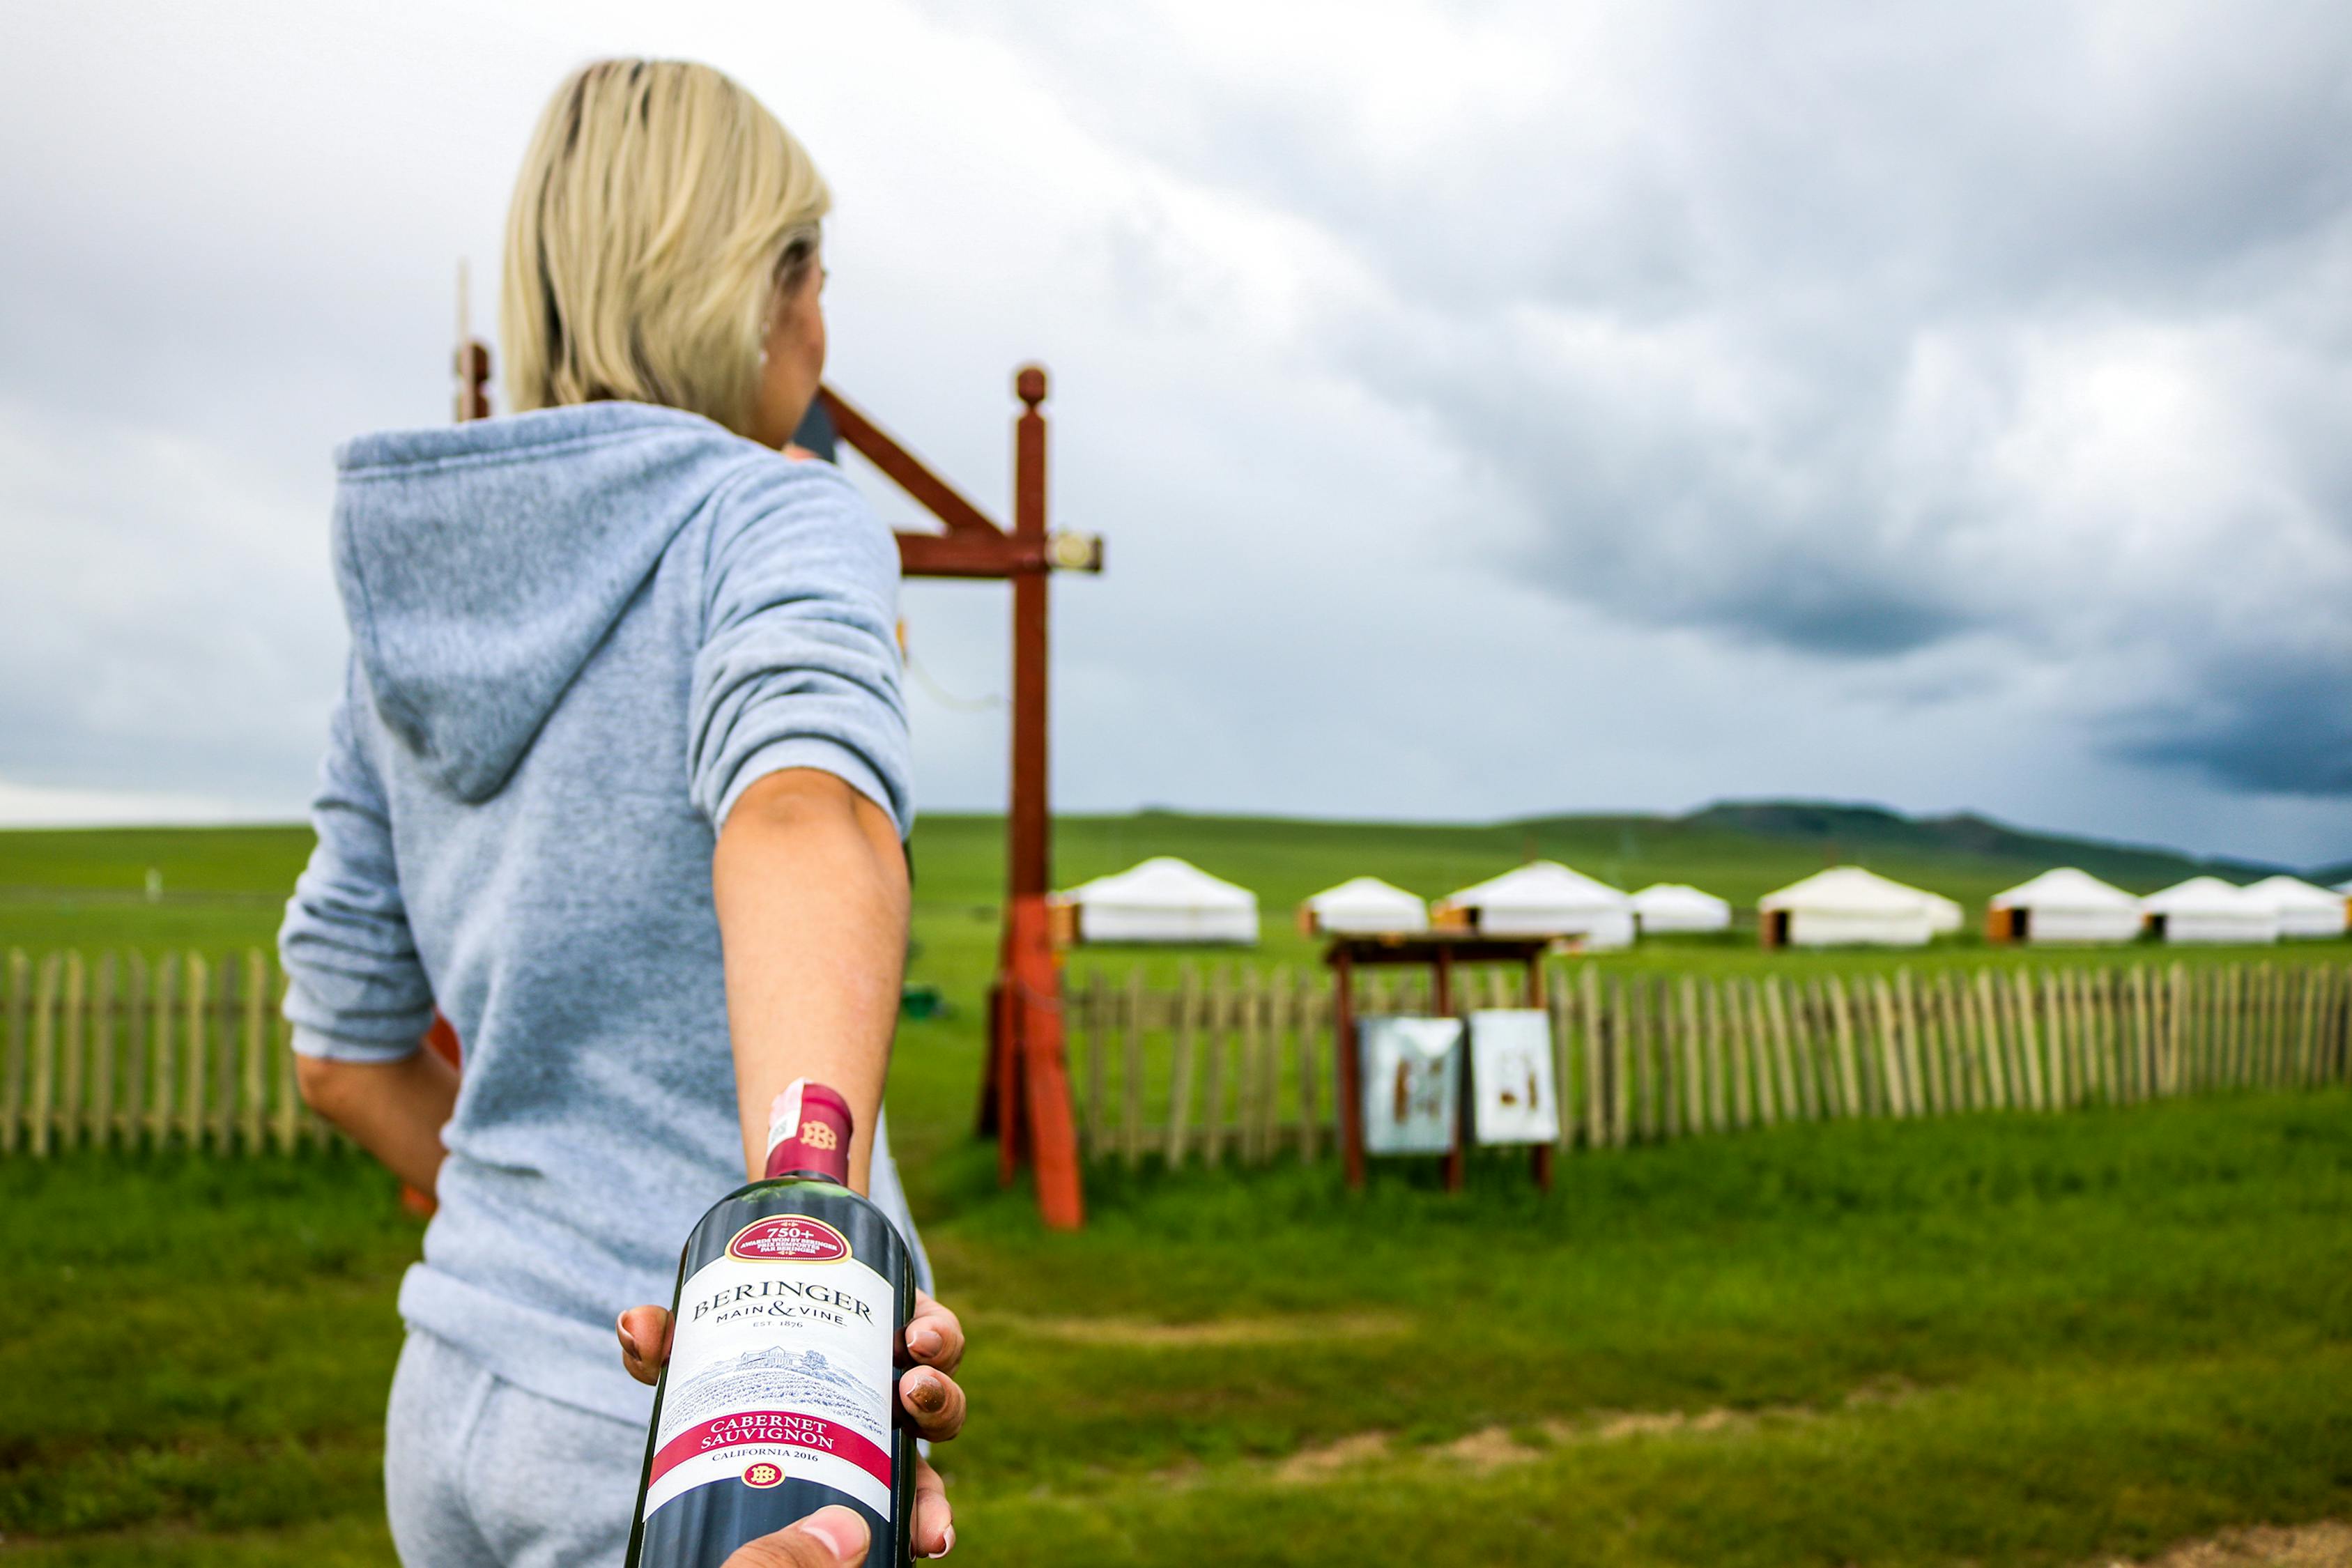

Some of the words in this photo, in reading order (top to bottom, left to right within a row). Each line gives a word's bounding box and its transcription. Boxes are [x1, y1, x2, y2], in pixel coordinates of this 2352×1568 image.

[767, 1228, 814, 1238] 750+
[741, 1238, 771, 1249] AWARDS
[801, 1238, 838, 1251] BERINGER
[693, 1280, 875, 1327] BERINGER
[716, 1306, 764, 1323] MAIN
[768, 1300, 797, 1316] &
[710, 1415, 827, 1434] CABERNET
[701, 1427, 834, 1450] SAUVIGNON
[712, 1448, 790, 1461] CALIFORNIA
[794, 1451, 818, 1462] 2016
